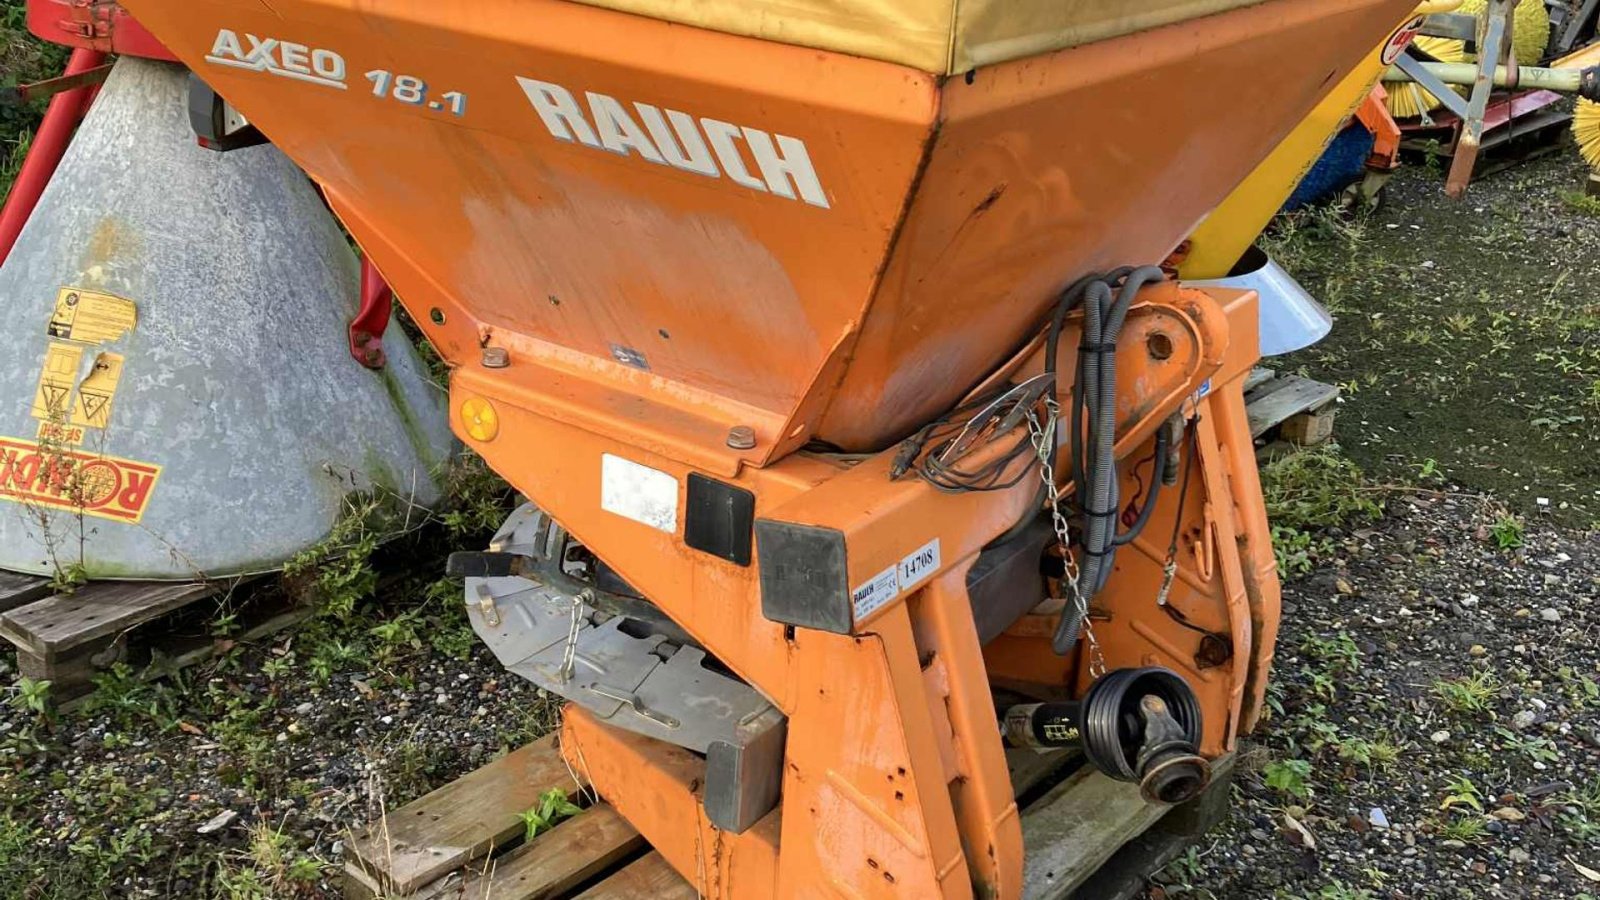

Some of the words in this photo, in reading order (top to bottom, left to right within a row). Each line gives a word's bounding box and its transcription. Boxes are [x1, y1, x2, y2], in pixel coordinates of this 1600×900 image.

[210, 29, 346, 81] AXEO
[364, 69, 467, 117] 18.1
[515, 76, 830, 209] RAUCH
[0, 447, 155, 511] RONDI
[854, 583, 874, 604] RAUCH
[904, 549, 933, 578] 14708
